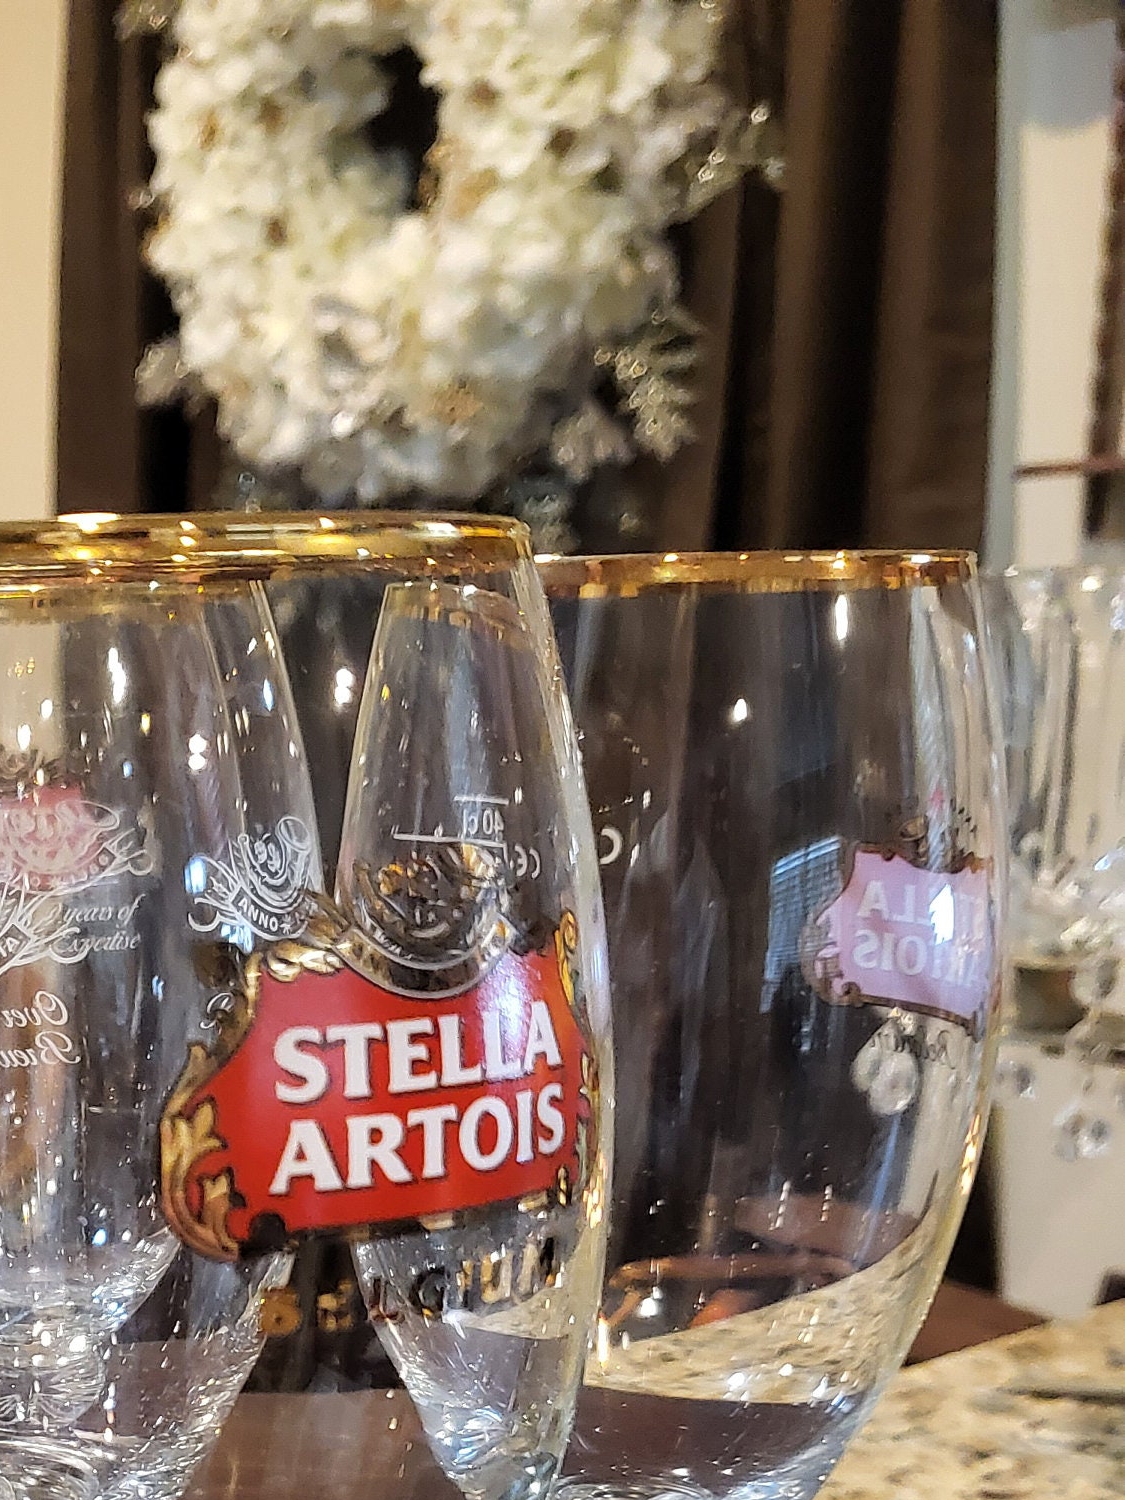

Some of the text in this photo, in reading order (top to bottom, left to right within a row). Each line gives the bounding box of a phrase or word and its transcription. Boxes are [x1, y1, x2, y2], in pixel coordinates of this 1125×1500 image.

[238, 897, 280, 933] ANNO
[274, 999, 564, 1105] STELLA
[268, 1083, 567, 1196] ARTOIS
